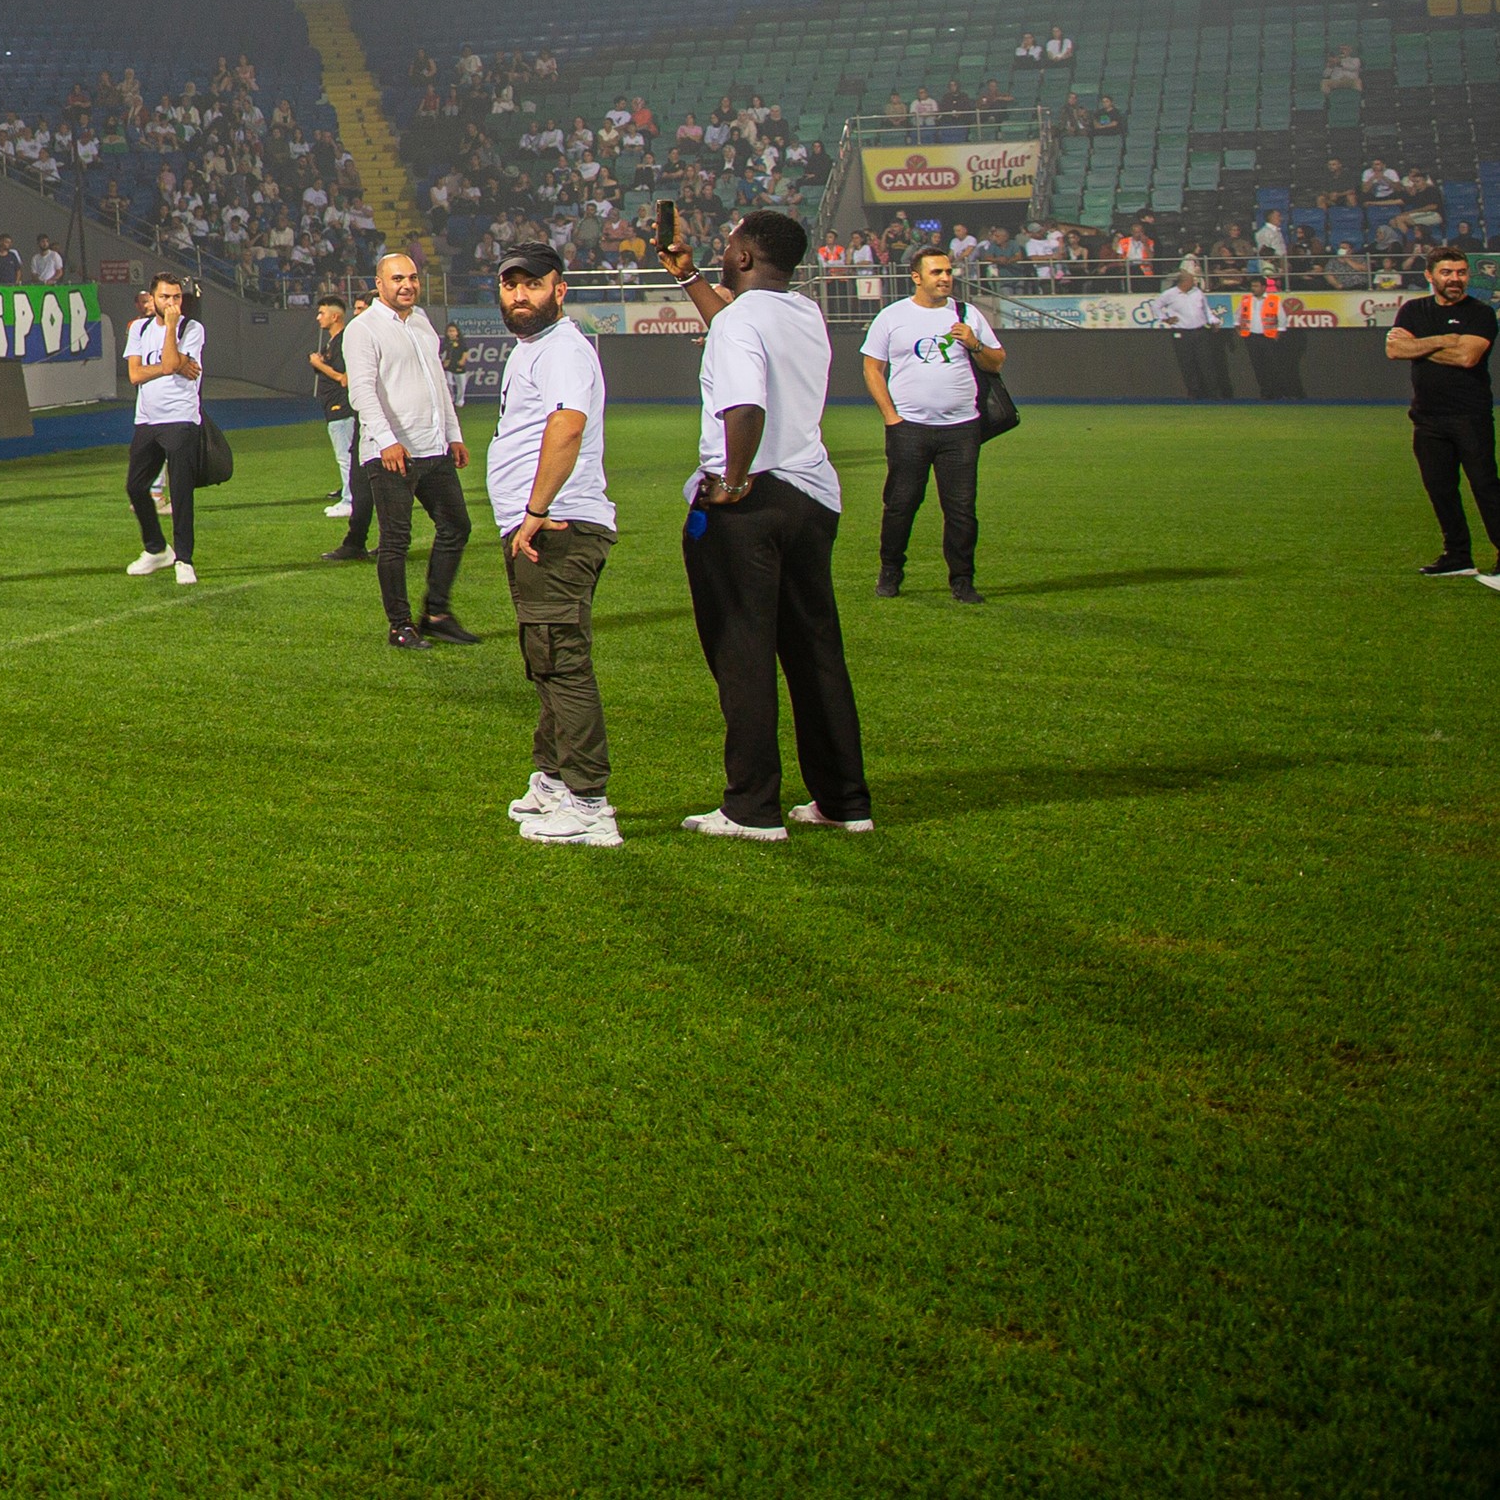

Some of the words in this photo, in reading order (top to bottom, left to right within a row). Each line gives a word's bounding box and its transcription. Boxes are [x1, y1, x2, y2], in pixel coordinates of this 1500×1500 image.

[967, 151, 1031, 177] Çaylar
[882, 171, 956, 190] ÇAYKUR
[970, 170, 1034, 192] Bizden
[865, 281, 872, 294] 7
